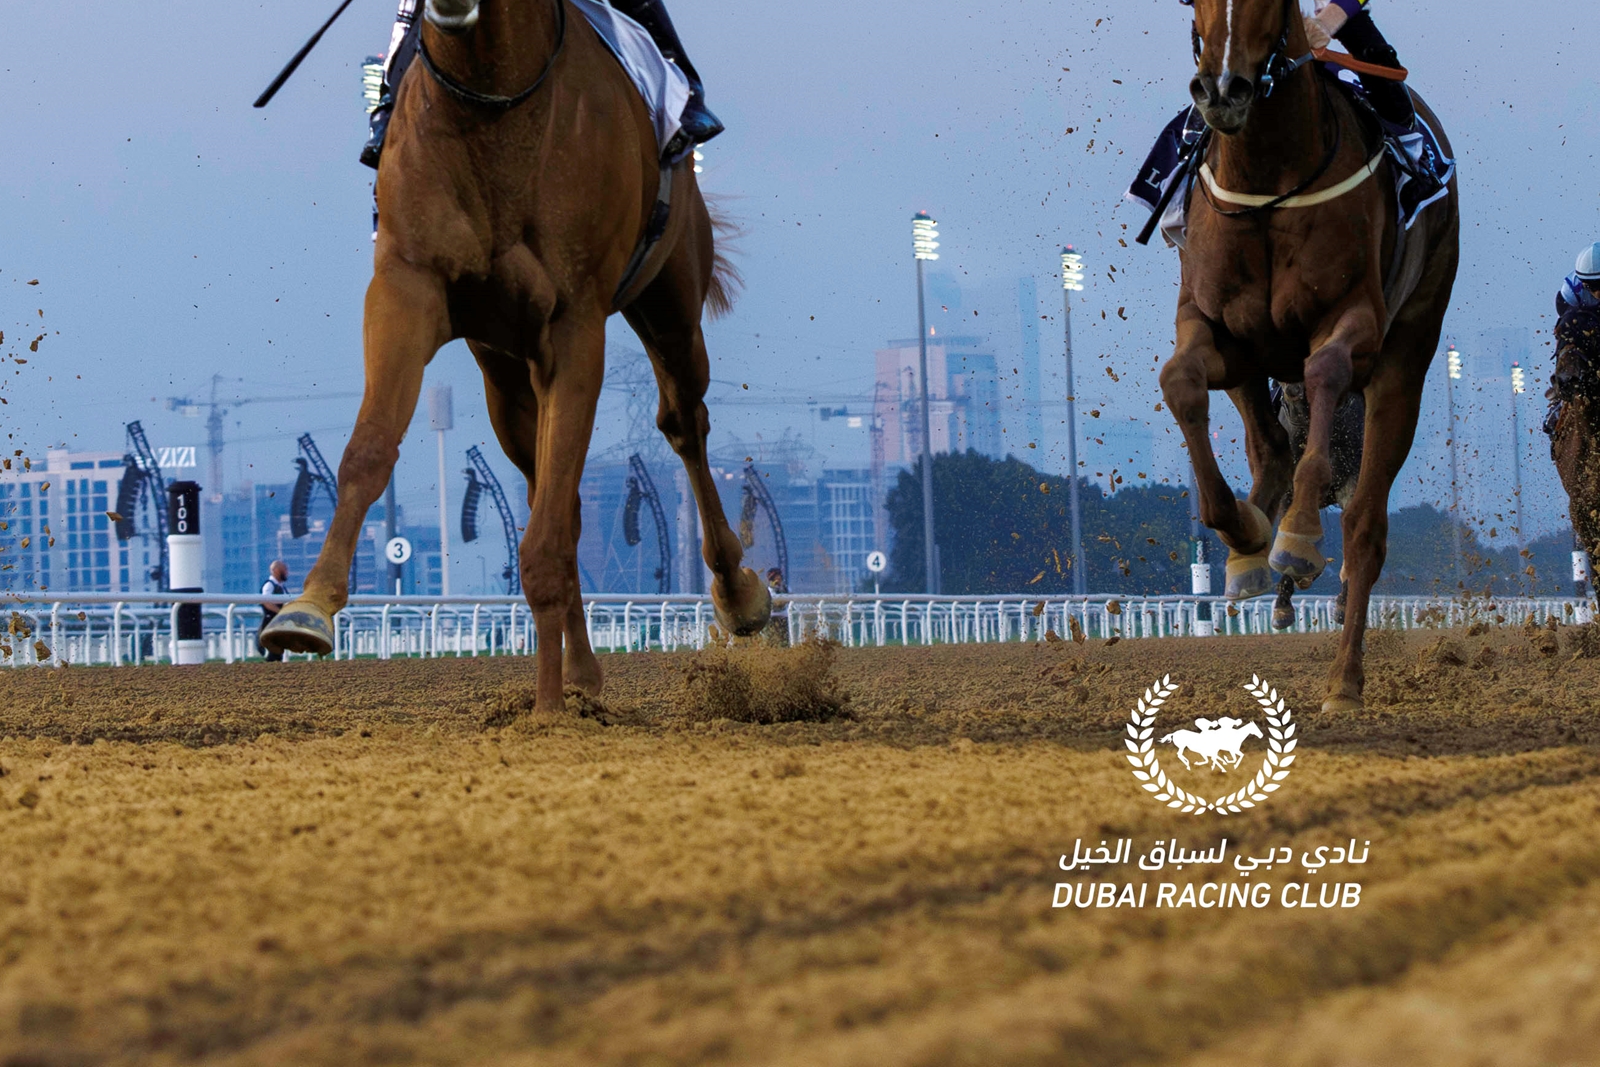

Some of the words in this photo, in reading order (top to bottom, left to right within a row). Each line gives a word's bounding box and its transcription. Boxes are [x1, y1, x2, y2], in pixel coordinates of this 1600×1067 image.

[177, 494, 187, 533] 100
[394, 542, 404, 559] 3
[872, 554, 881, 568] 4
